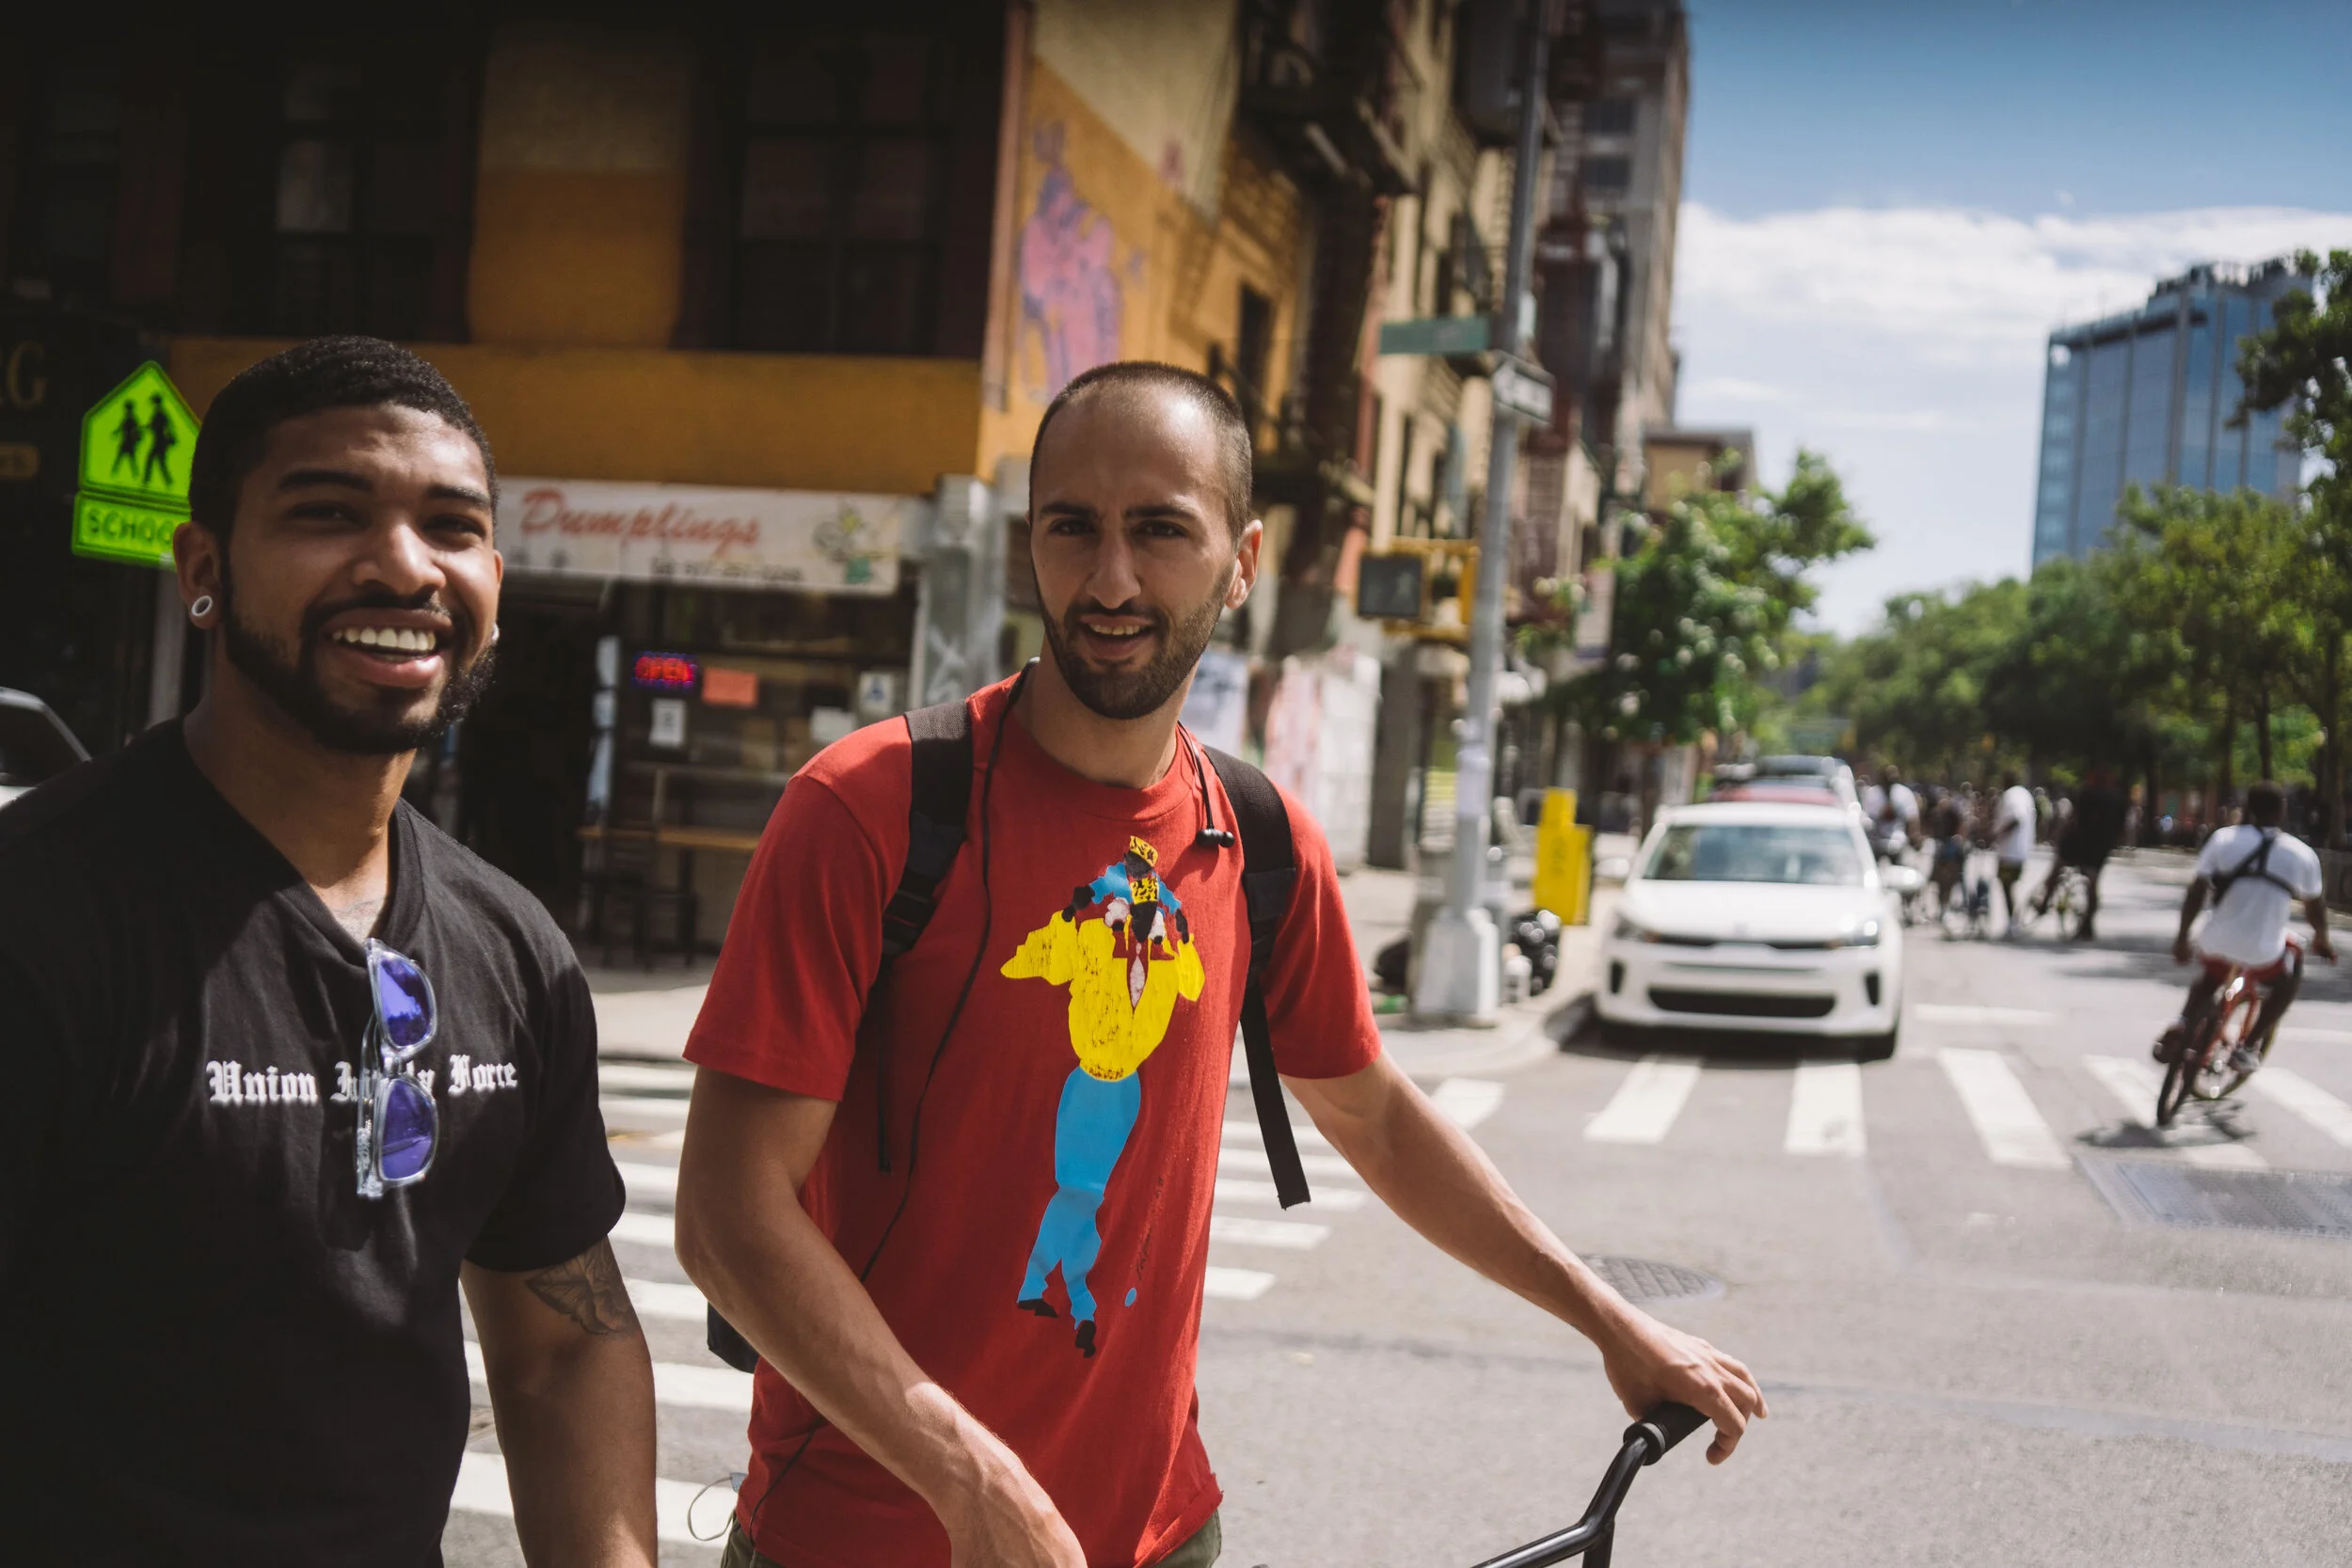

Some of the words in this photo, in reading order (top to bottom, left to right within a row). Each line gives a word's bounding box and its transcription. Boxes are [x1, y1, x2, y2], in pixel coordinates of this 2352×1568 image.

[87, 507, 176, 547] SCHOO
[520, 487, 760, 559] Dumplings
[206, 1060, 319, 1105] Union
[448, 1053, 518, 1096] Force
